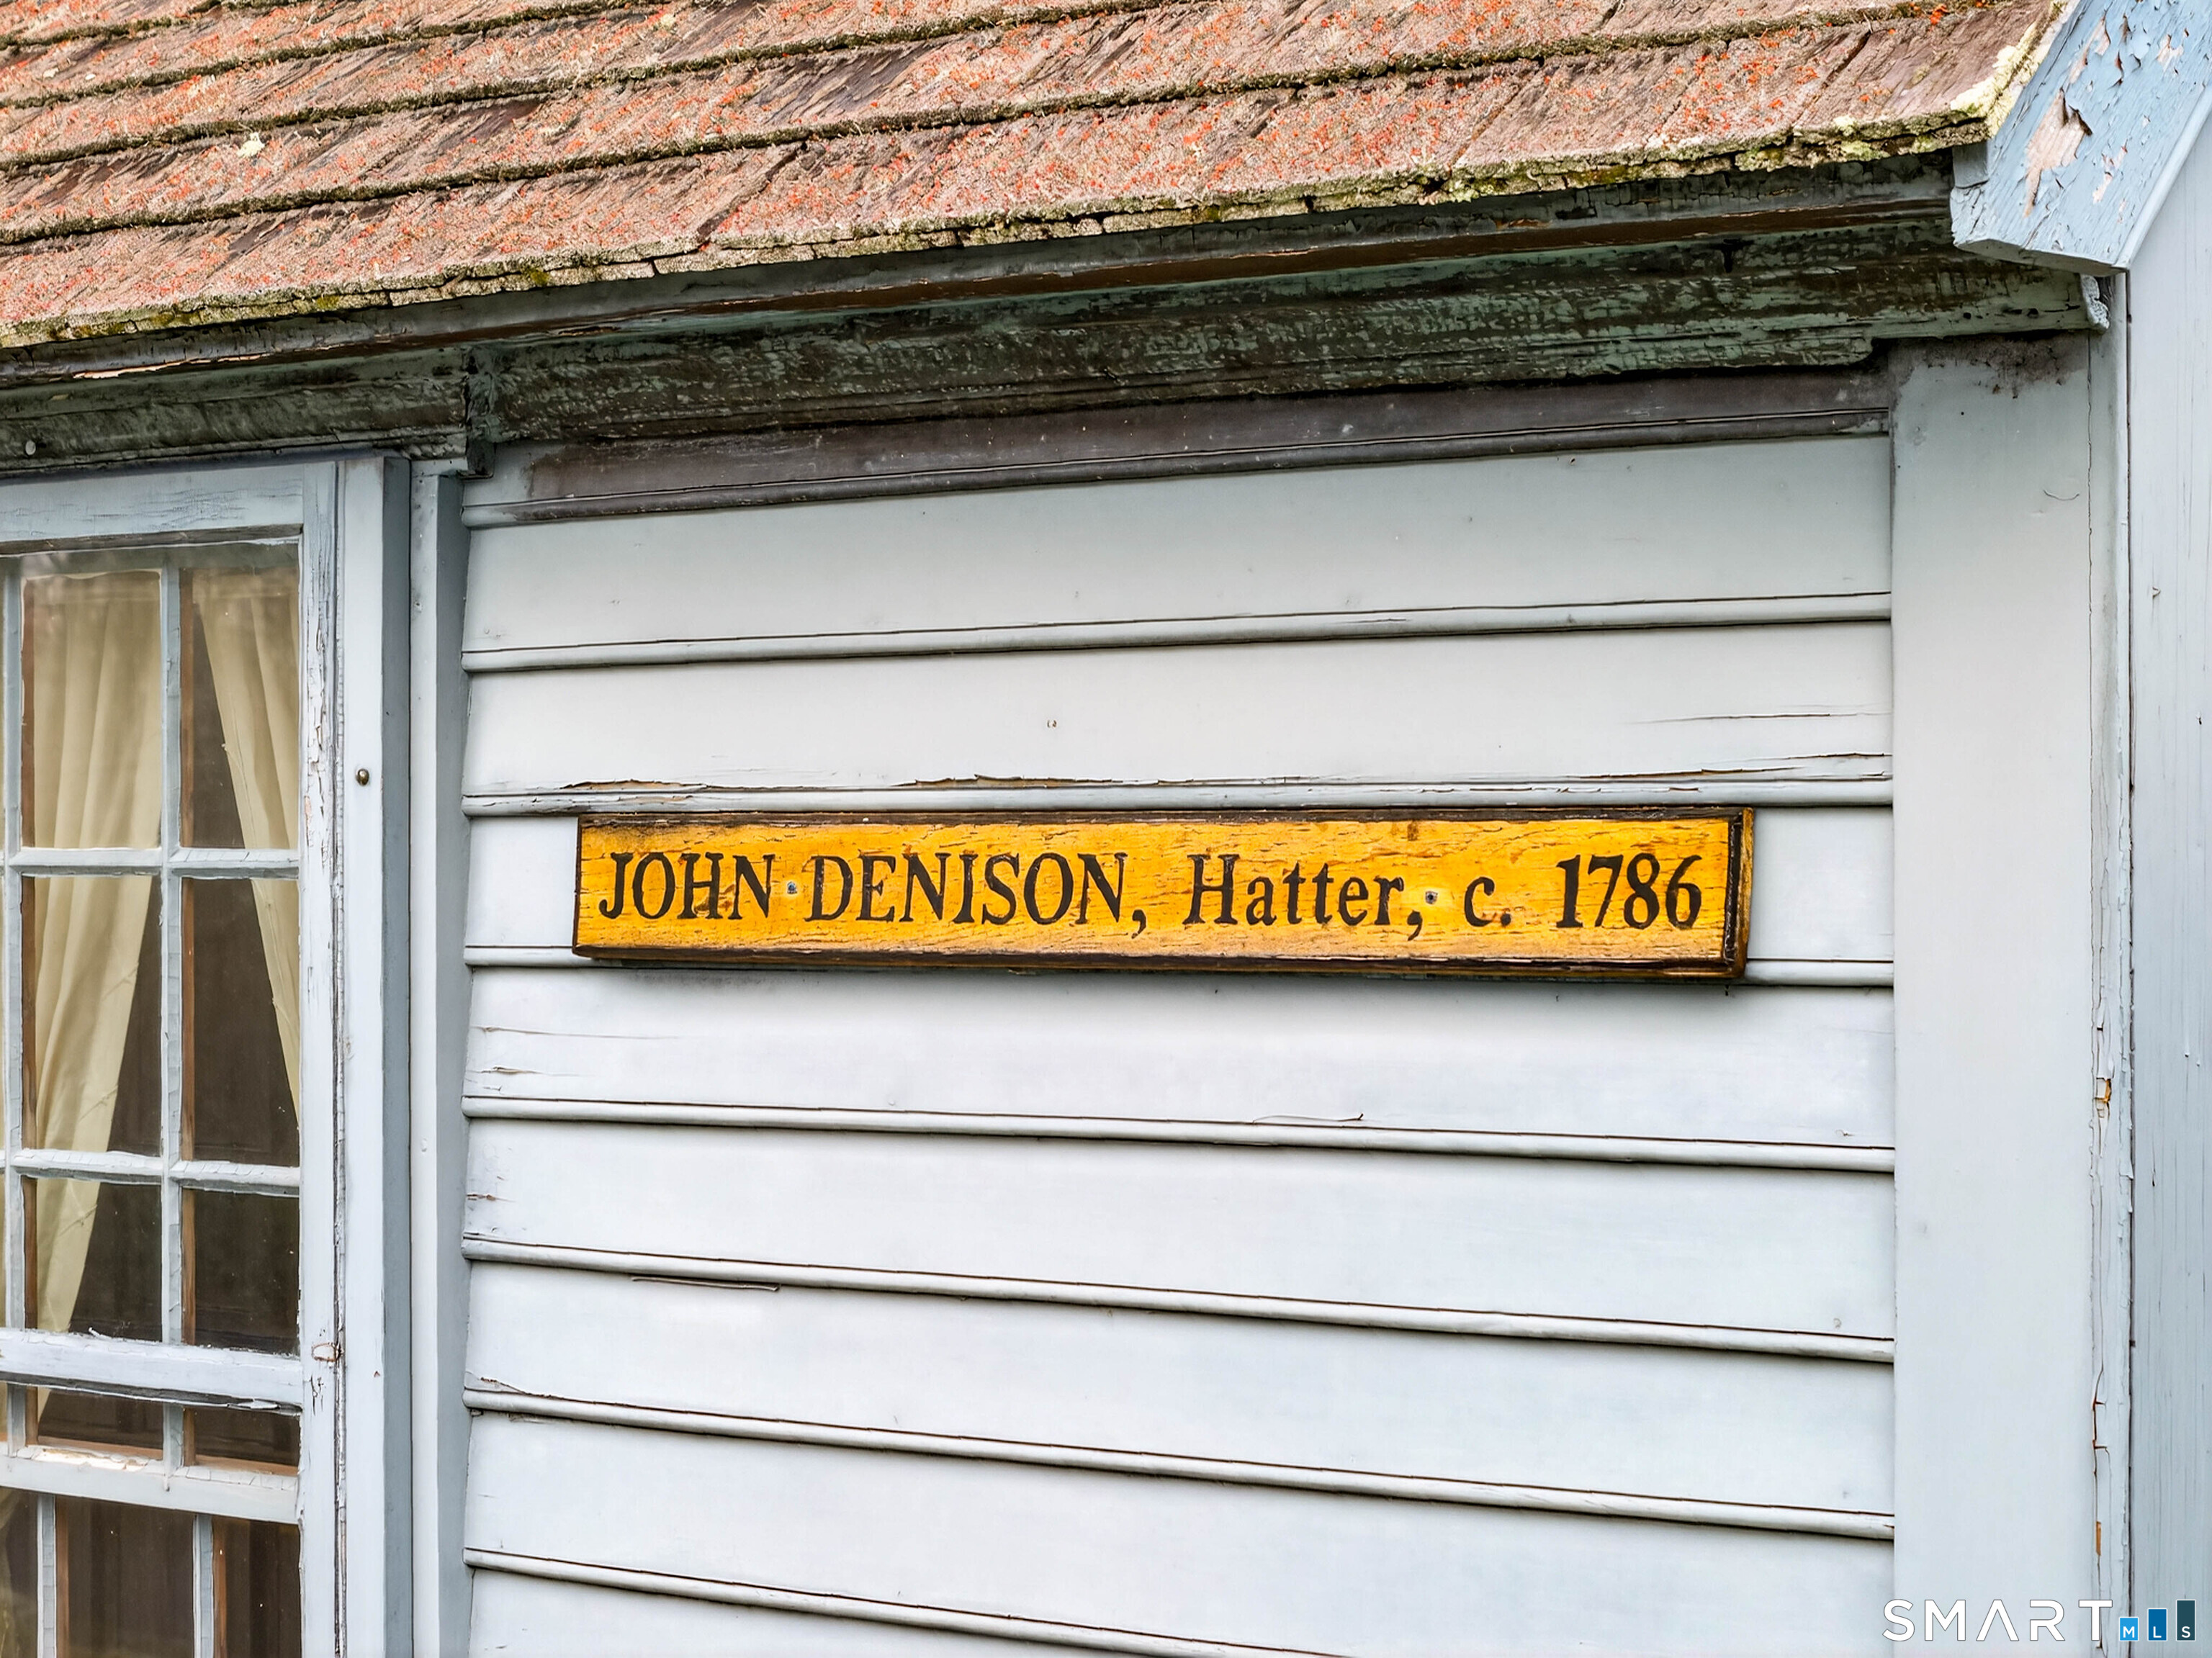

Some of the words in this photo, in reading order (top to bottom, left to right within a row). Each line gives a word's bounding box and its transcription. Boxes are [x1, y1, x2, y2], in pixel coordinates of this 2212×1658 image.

[599, 852, 775, 922] JOHN
[805, 852, 1146, 939] DENISON,
[1182, 854, 1423, 941] Hatter,
[1463, 876, 1512, 928] c.
[1555, 853, 1703, 929] 1786
